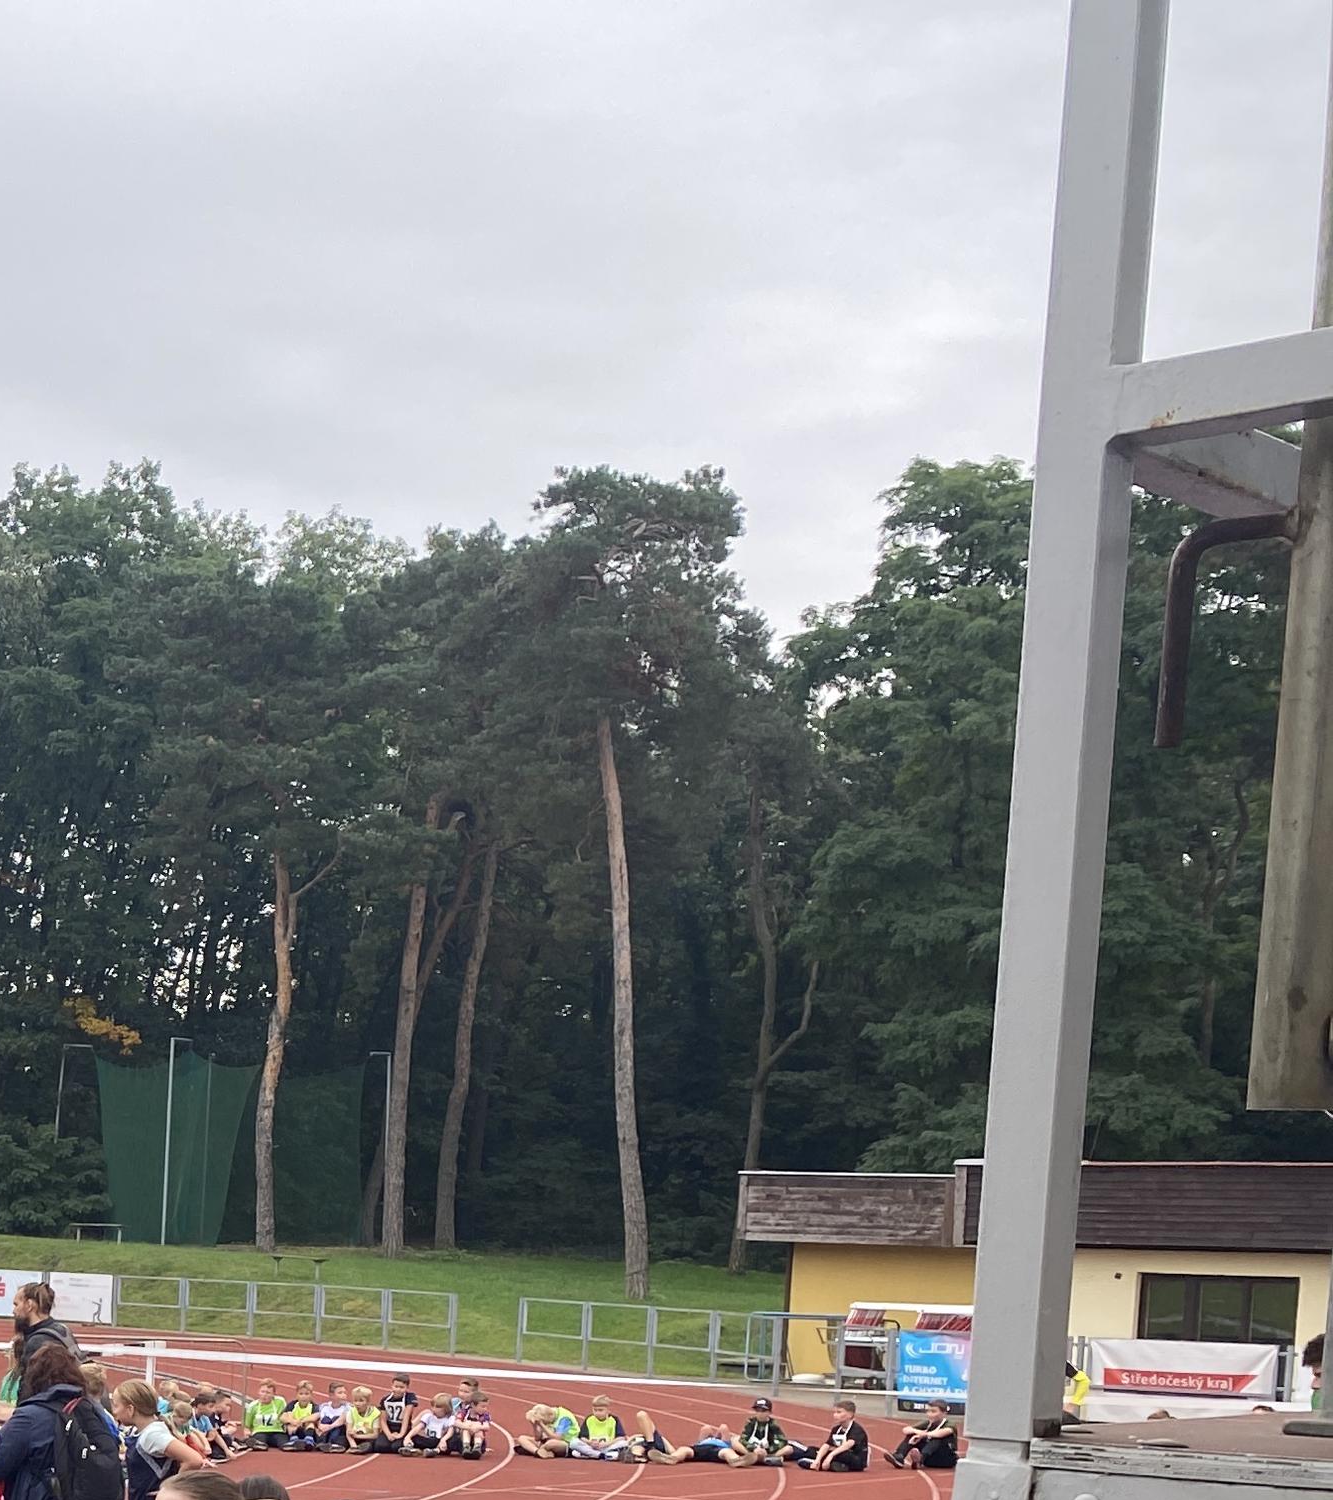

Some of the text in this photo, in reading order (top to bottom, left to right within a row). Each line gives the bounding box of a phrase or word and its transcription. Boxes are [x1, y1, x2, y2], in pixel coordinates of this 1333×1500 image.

[1120, 1371, 1234, 1391] Středočeský kraj
[387, 1404, 403, 1422] 32
